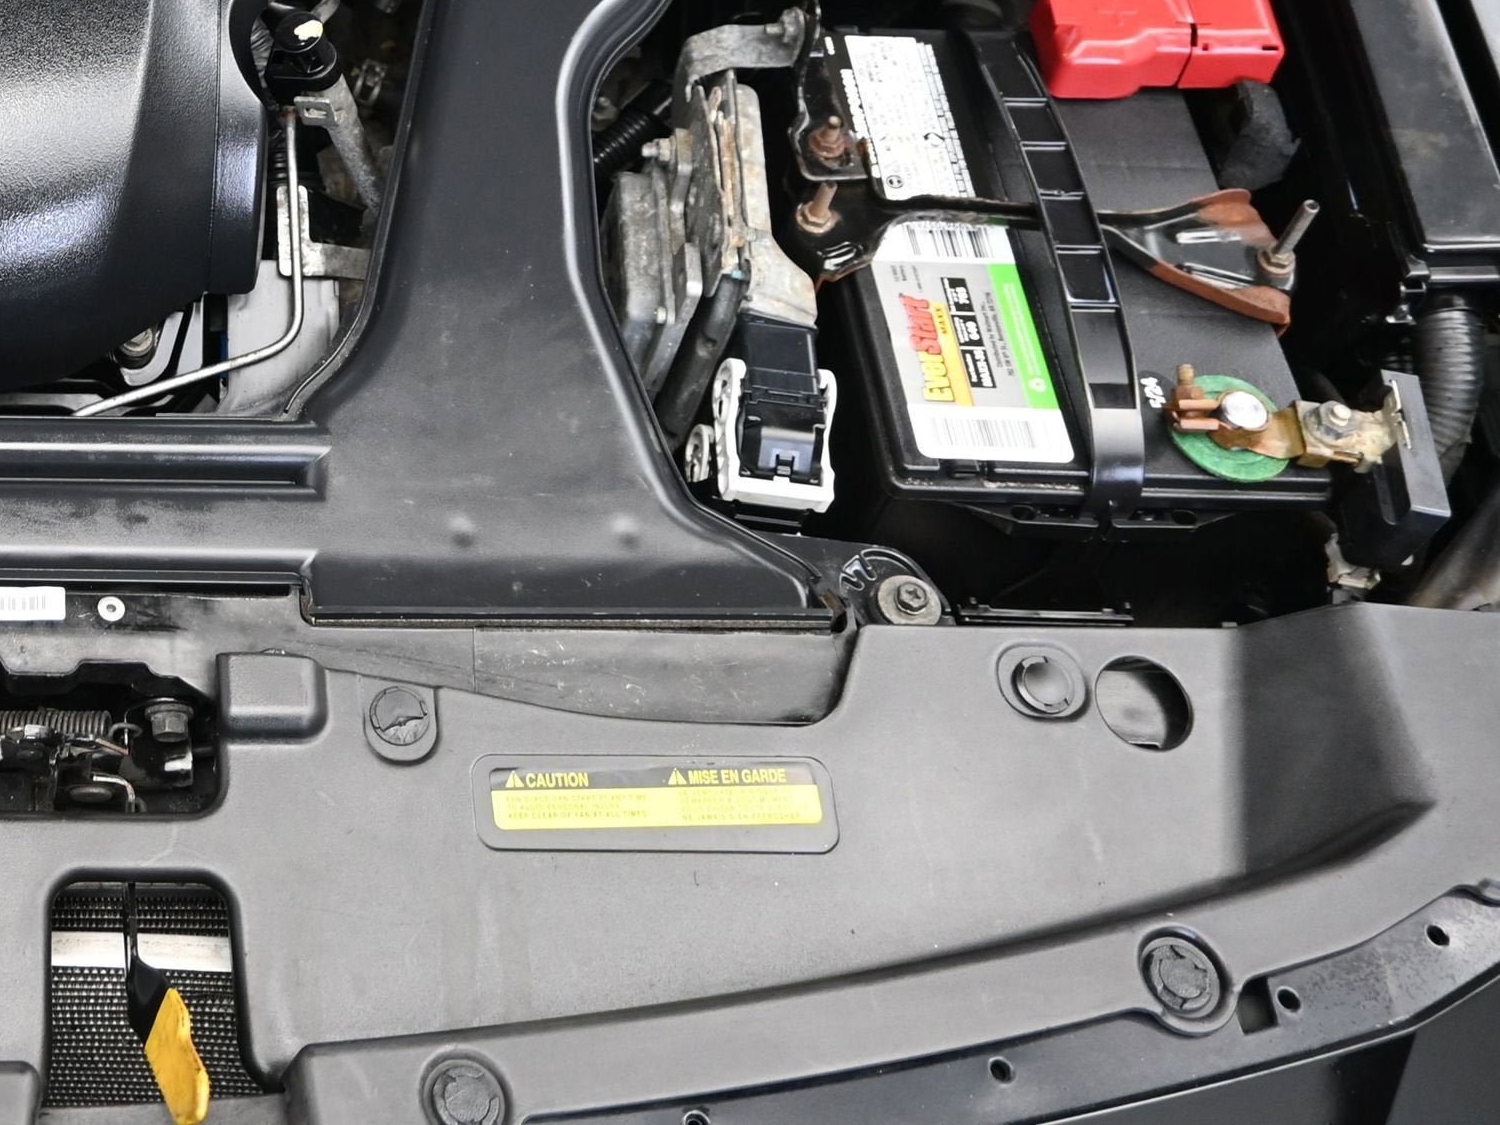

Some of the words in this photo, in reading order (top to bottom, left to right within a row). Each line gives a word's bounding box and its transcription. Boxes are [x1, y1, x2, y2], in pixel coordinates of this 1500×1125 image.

[934, 307, 948, 334] MAXX
[901, 295, 956, 403] EverStart
[525, 772, 589, 788] CAUTION
[687, 770, 719, 785] MISE
[721, 769, 740, 784] EN
[741, 768, 788, 783] GARDE
